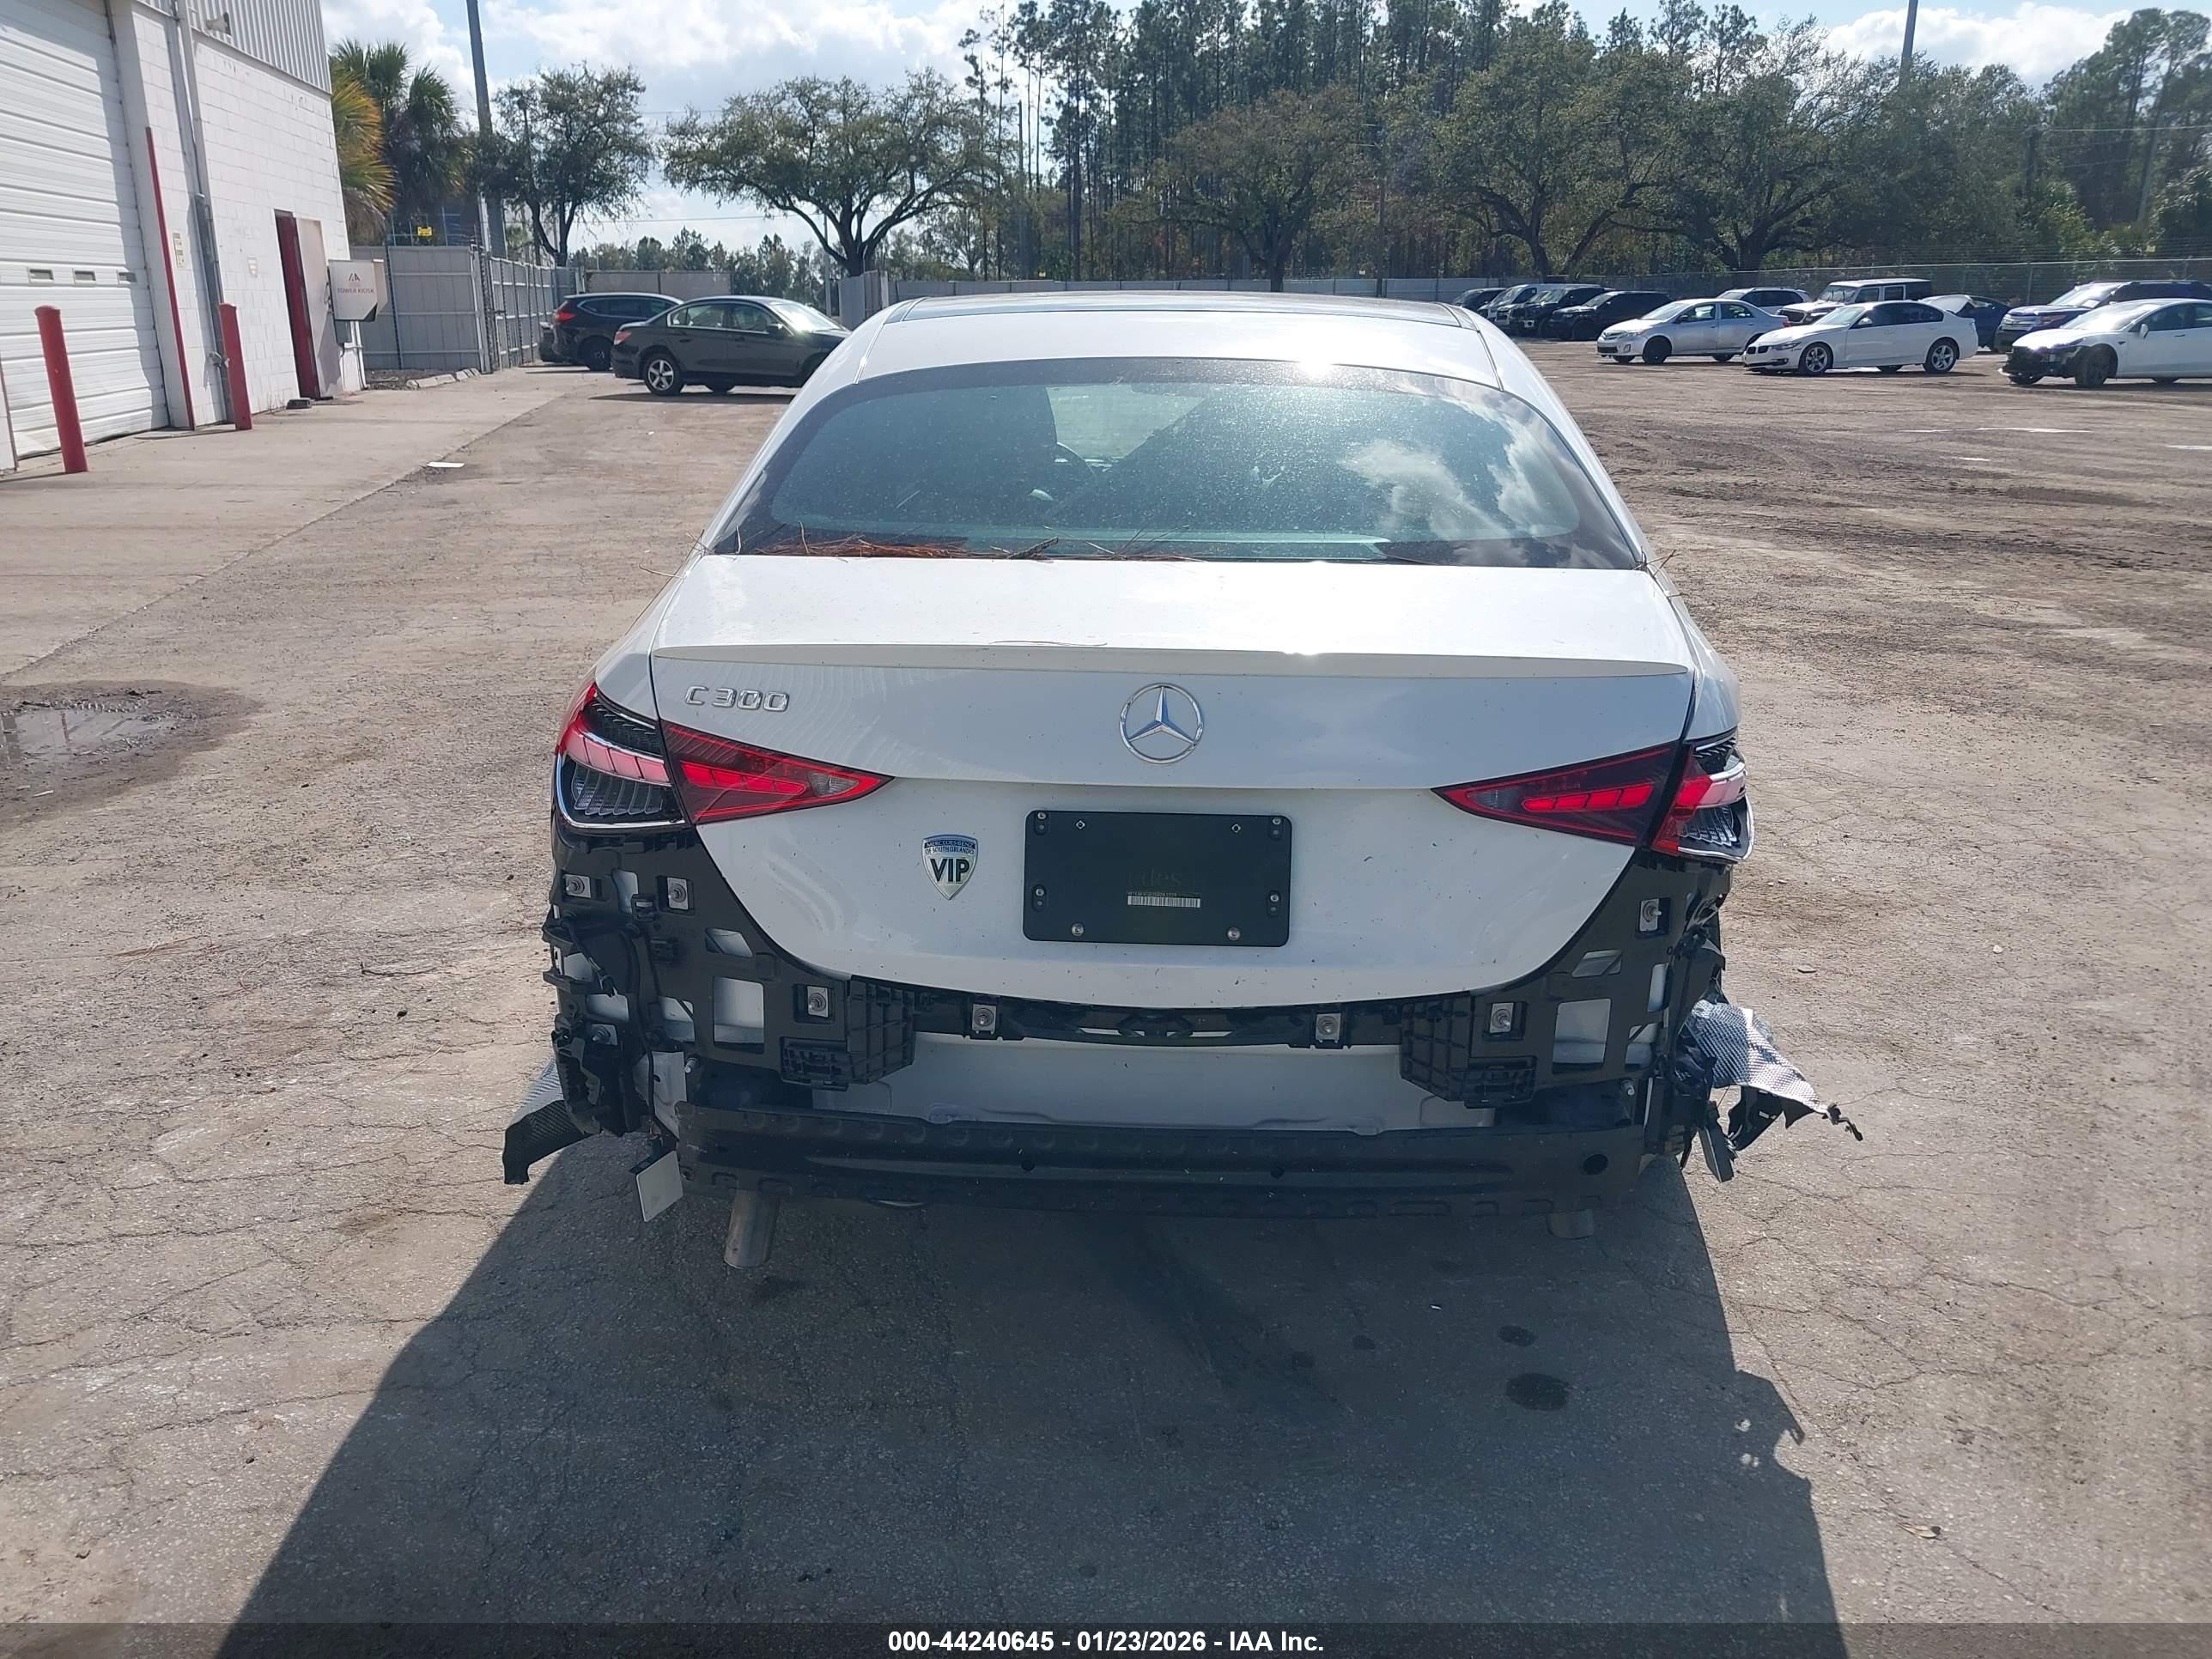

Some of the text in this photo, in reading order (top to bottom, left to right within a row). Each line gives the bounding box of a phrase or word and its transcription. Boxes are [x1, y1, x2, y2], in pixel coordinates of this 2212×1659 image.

[684, 685, 790, 713] C 300
[930, 858, 970, 883] VIP
